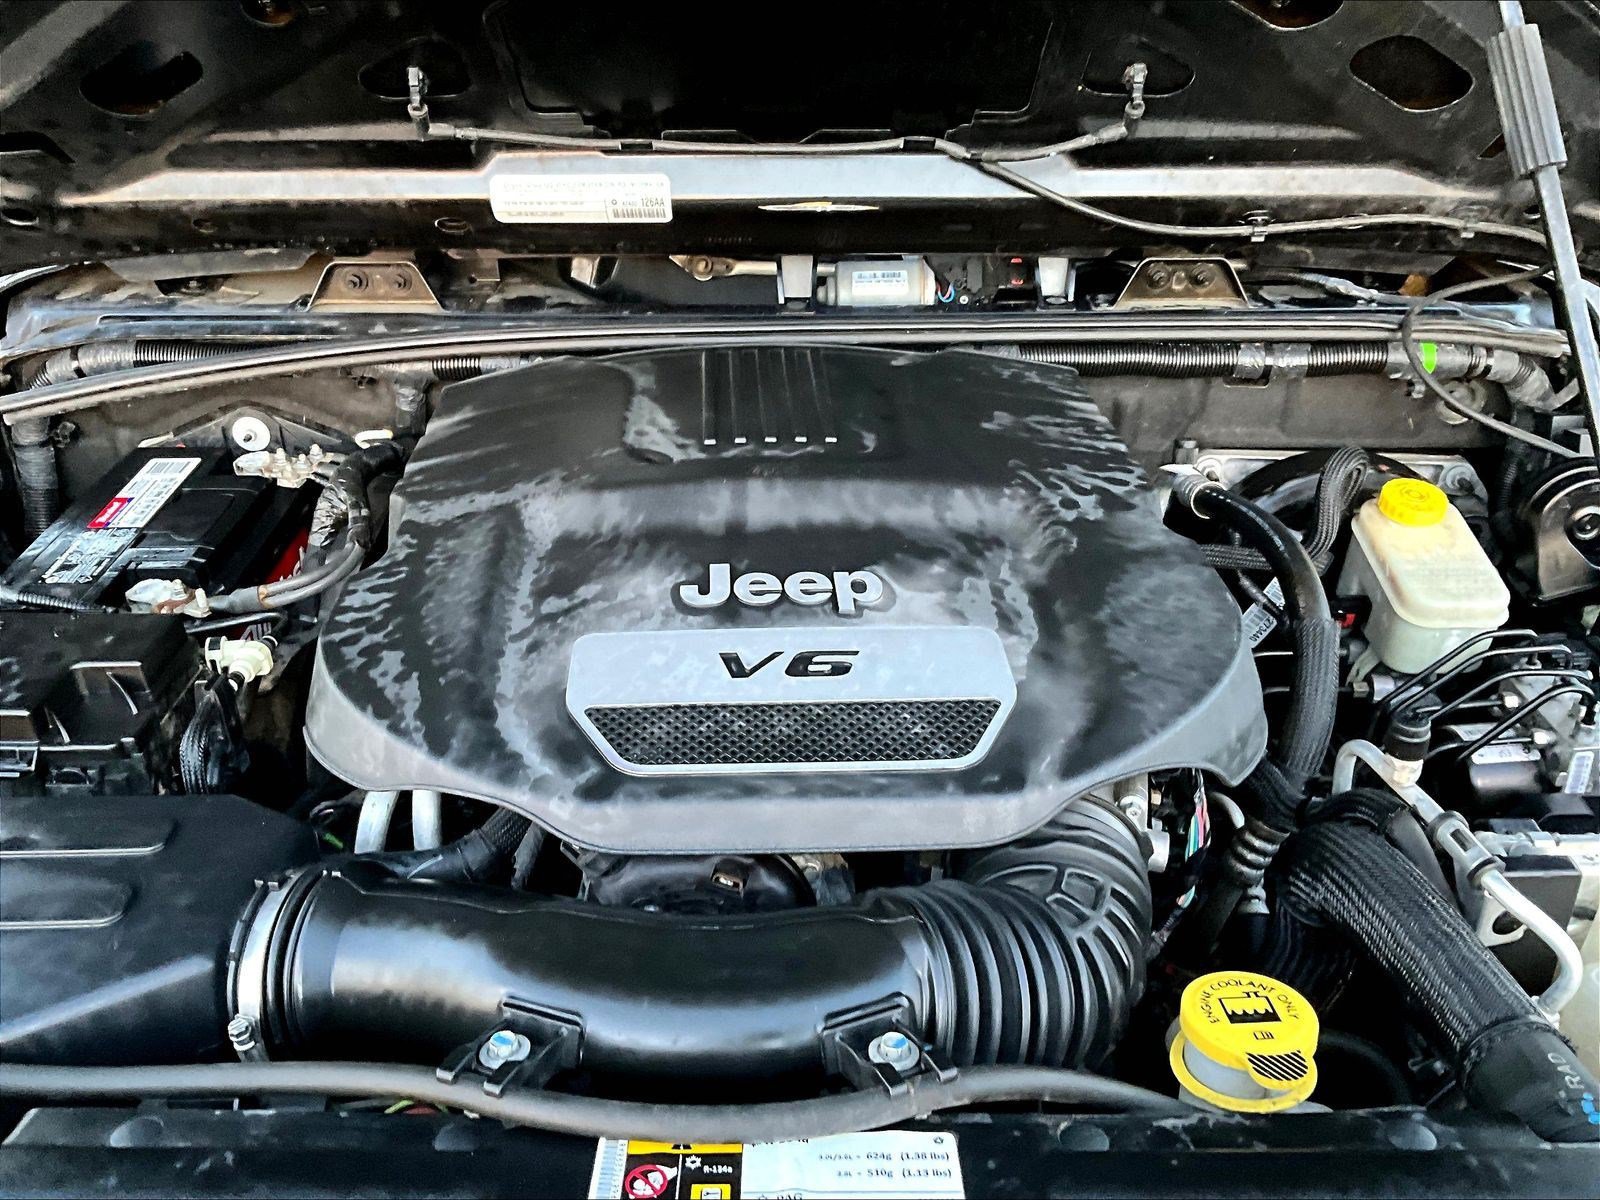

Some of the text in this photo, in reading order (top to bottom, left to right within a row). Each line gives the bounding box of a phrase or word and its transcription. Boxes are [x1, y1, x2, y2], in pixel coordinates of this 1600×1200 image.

[679, 563, 883, 614] Jeep
[719, 650, 860, 679] V6
[1209, 978, 1277, 994] COOLANT
[1277, 993, 1300, 1020] ONLY
[866, 1152, 892, 1161] 624g
[929, 1151, 950, 1162] lbs)
[867, 1168, 894, 1178] 510g
[931, 1167, 952, 1179] lbs)
